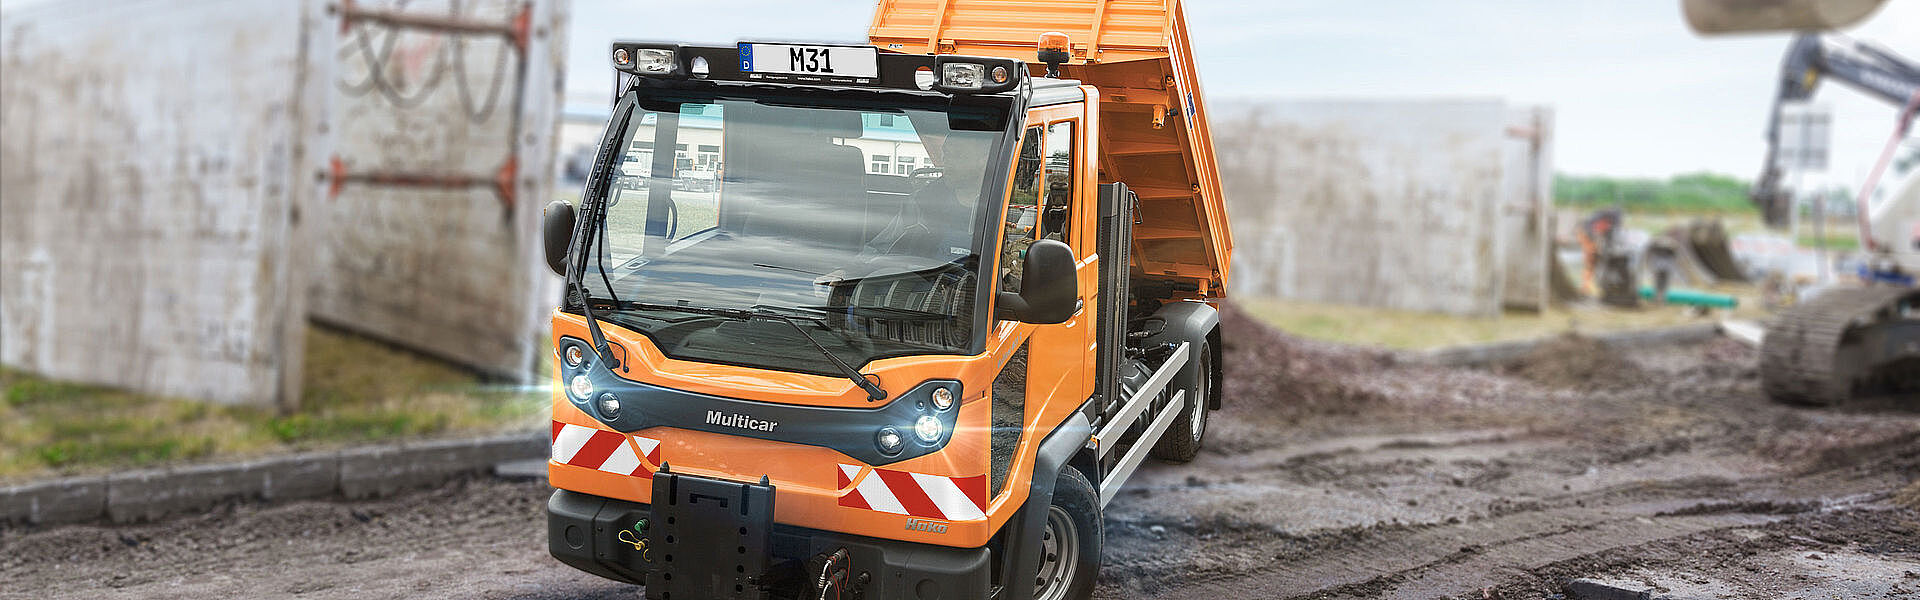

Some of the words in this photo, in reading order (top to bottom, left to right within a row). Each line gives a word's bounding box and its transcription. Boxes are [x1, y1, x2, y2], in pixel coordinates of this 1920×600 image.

[743, 60, 750, 70] D
[790, 47, 834, 73] M31
[706, 410, 778, 432] Multicar
[905, 518, 948, 534] Hako
